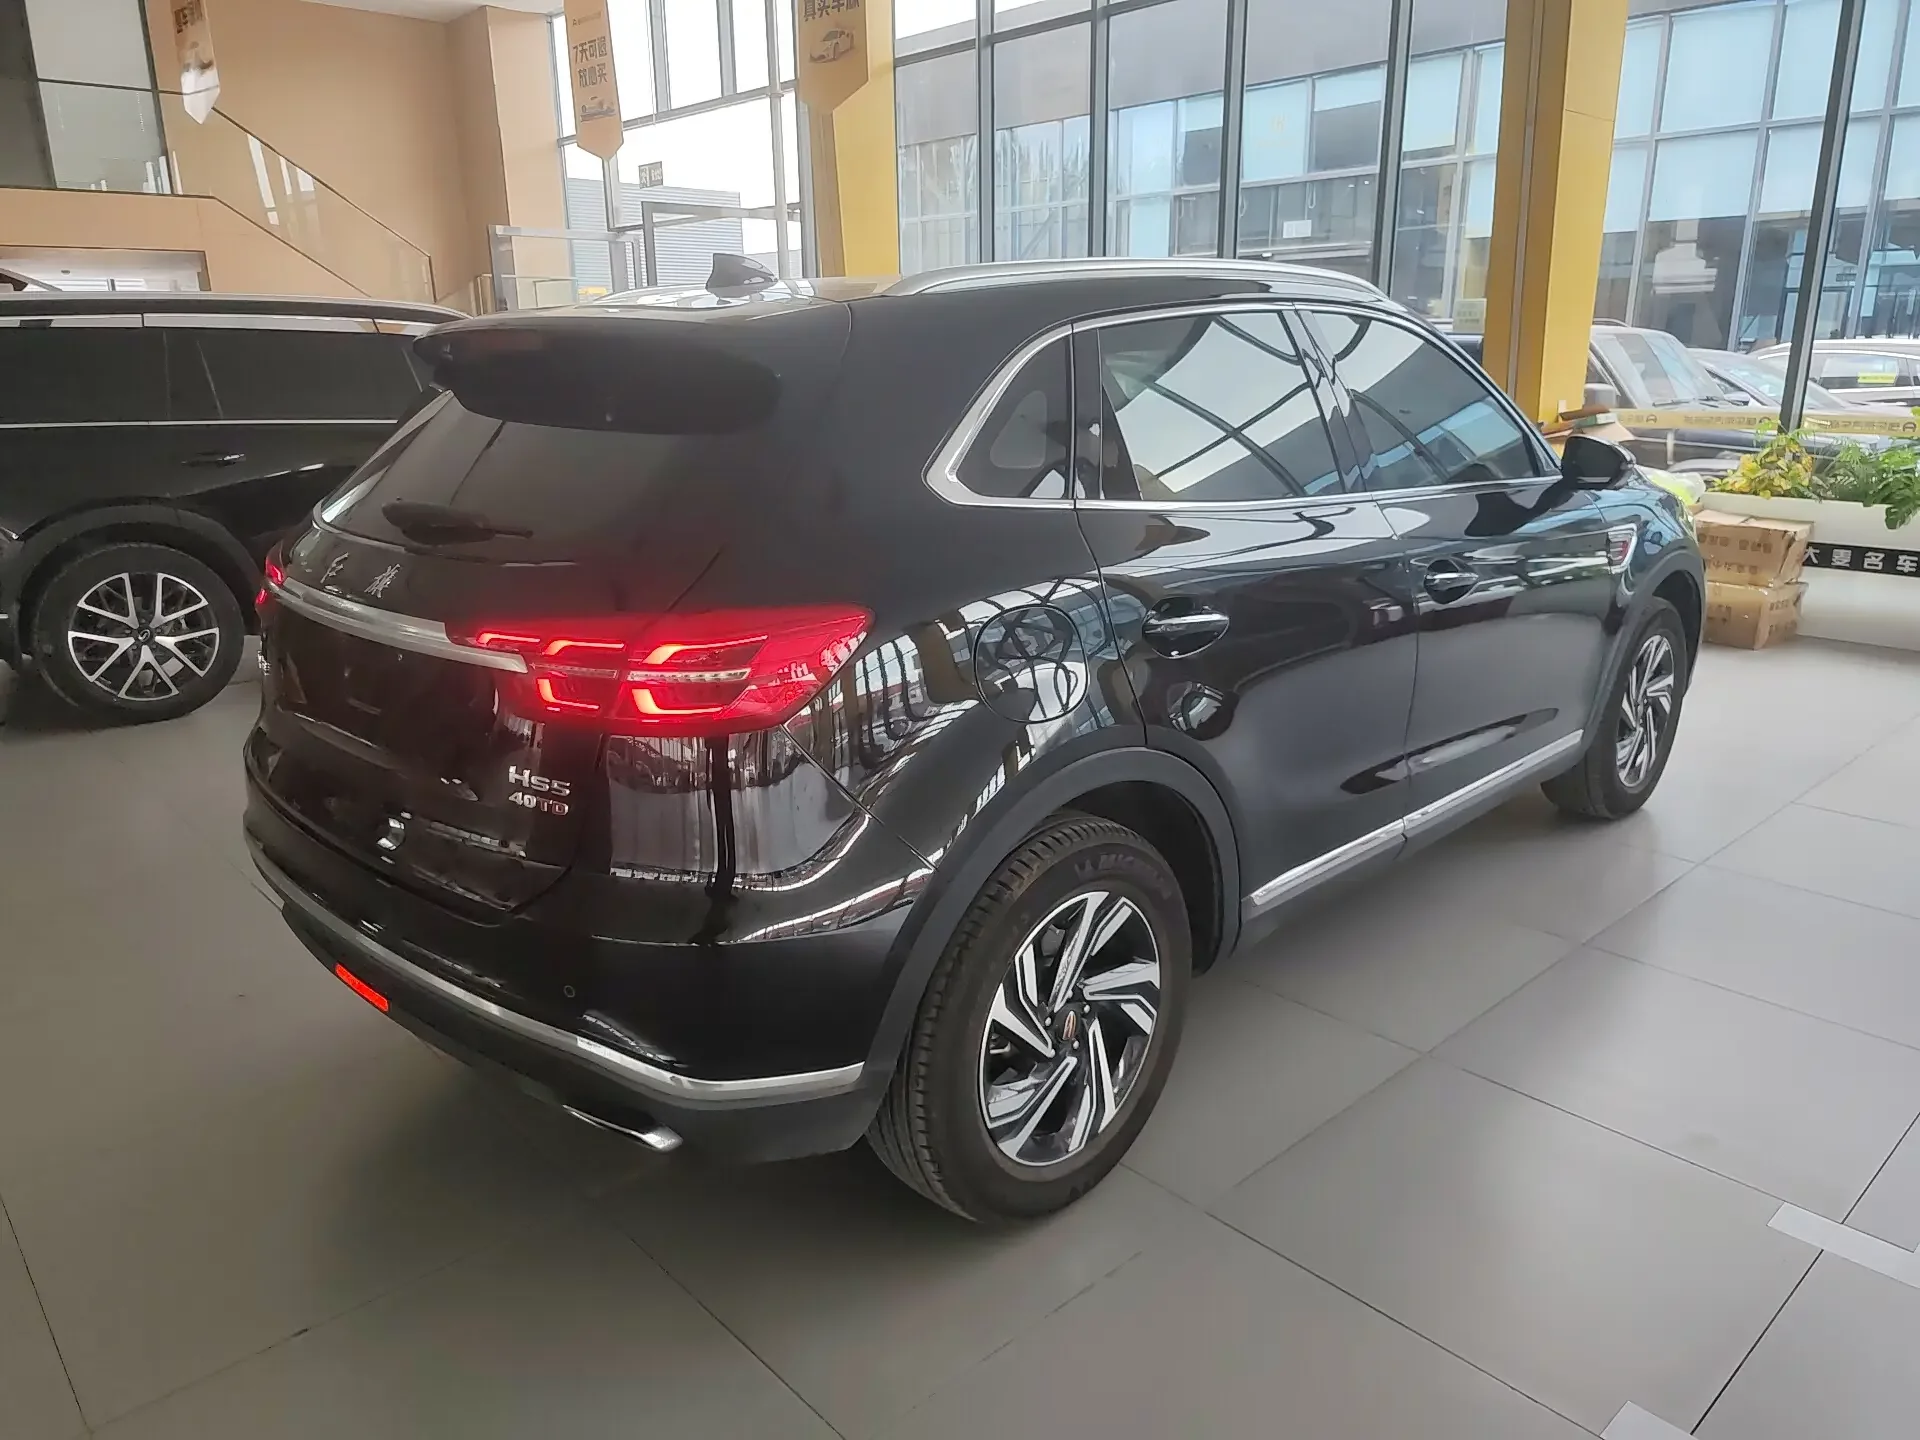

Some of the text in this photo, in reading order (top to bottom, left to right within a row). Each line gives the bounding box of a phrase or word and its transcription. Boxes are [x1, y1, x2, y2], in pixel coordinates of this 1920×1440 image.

[573, 36, 607, 64] 7天可退
[508, 765, 571, 796] HS5
[508, 791, 569, 815] 40TD
